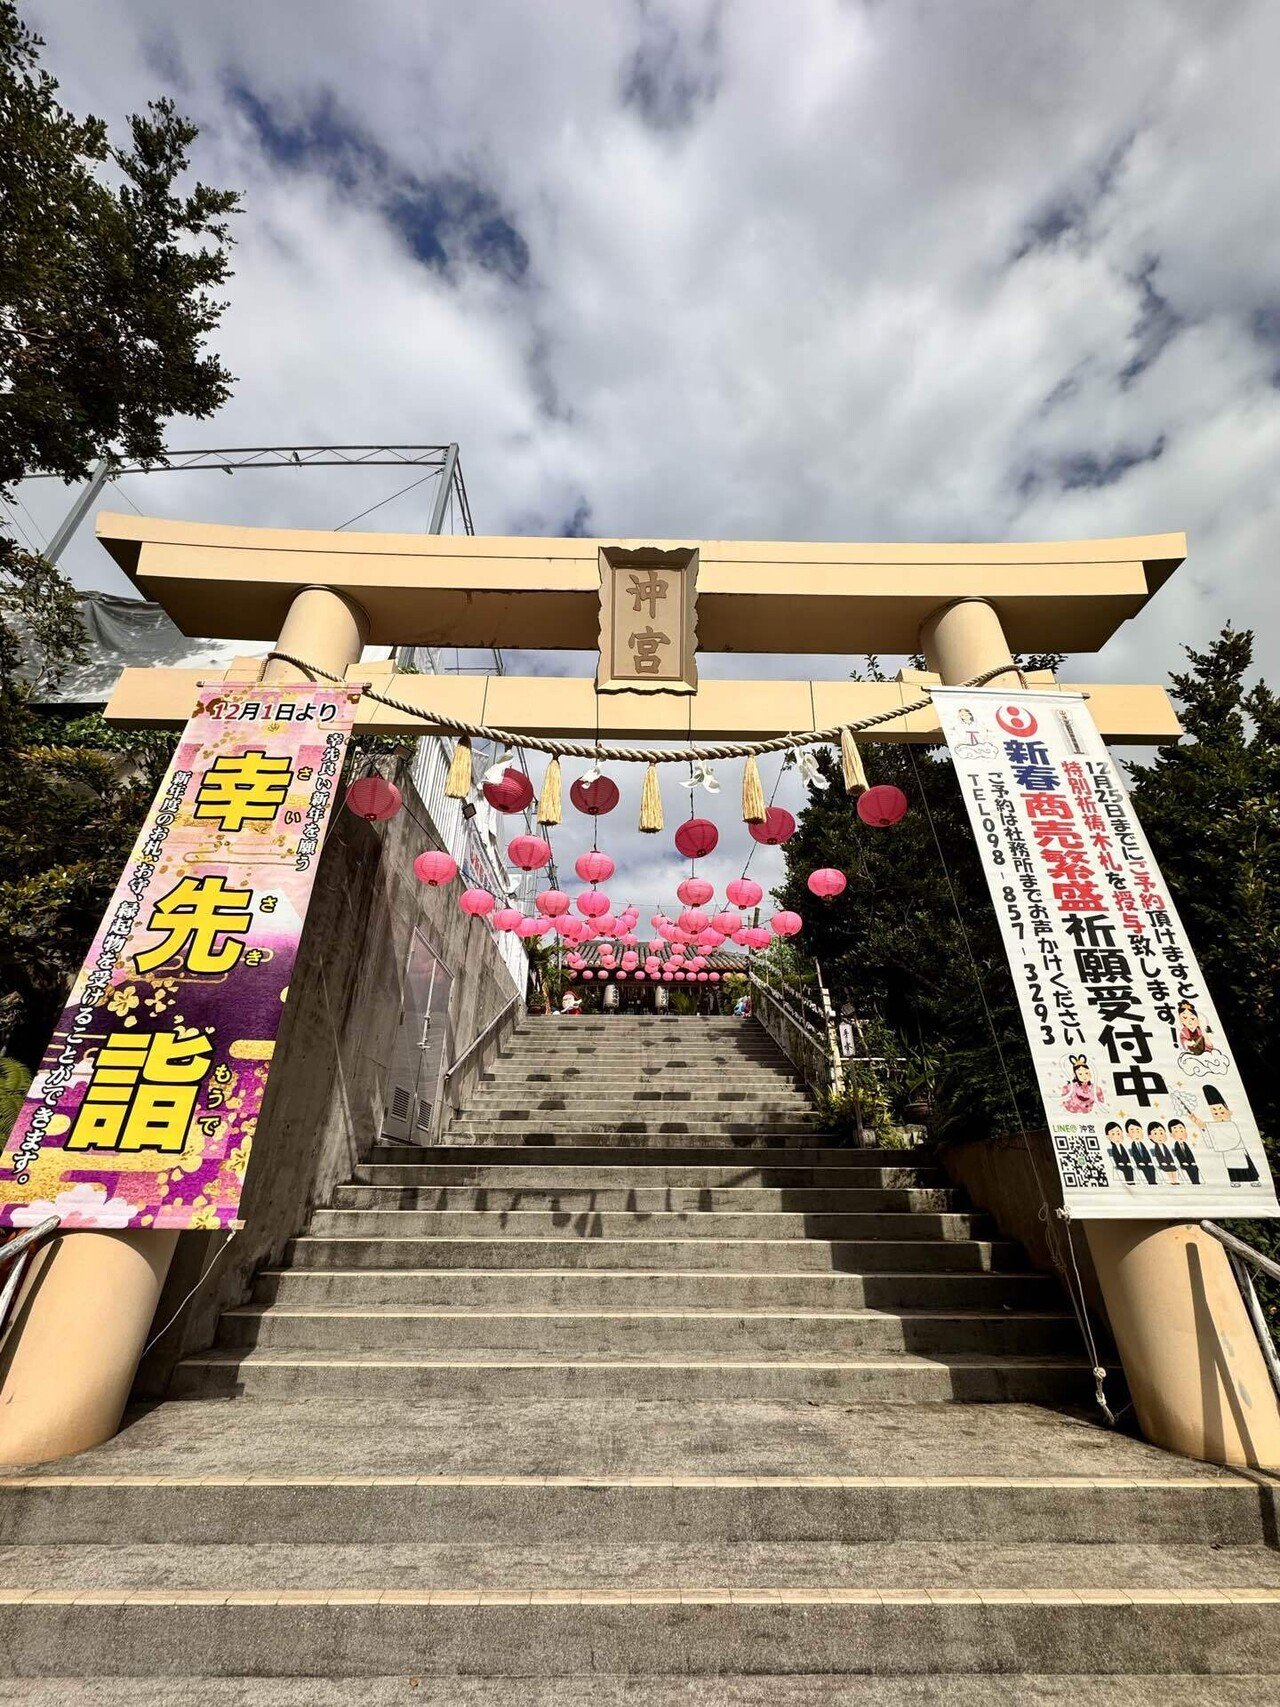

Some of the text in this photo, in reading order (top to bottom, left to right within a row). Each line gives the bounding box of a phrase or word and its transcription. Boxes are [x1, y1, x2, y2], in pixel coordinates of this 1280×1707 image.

[212, 703, 337, 722] 12月1日より
[285, 767, 312, 824] さい
[296, 734, 344, 872] 幸先良い新年を願う
[64, 750, 293, 1153] 幸先詣
[245, 896, 278, 966] さき
[1003, 740, 1168, 1107] 新春商売繁盛祈願受付中
[199, 1063, 232, 1137] もうで
